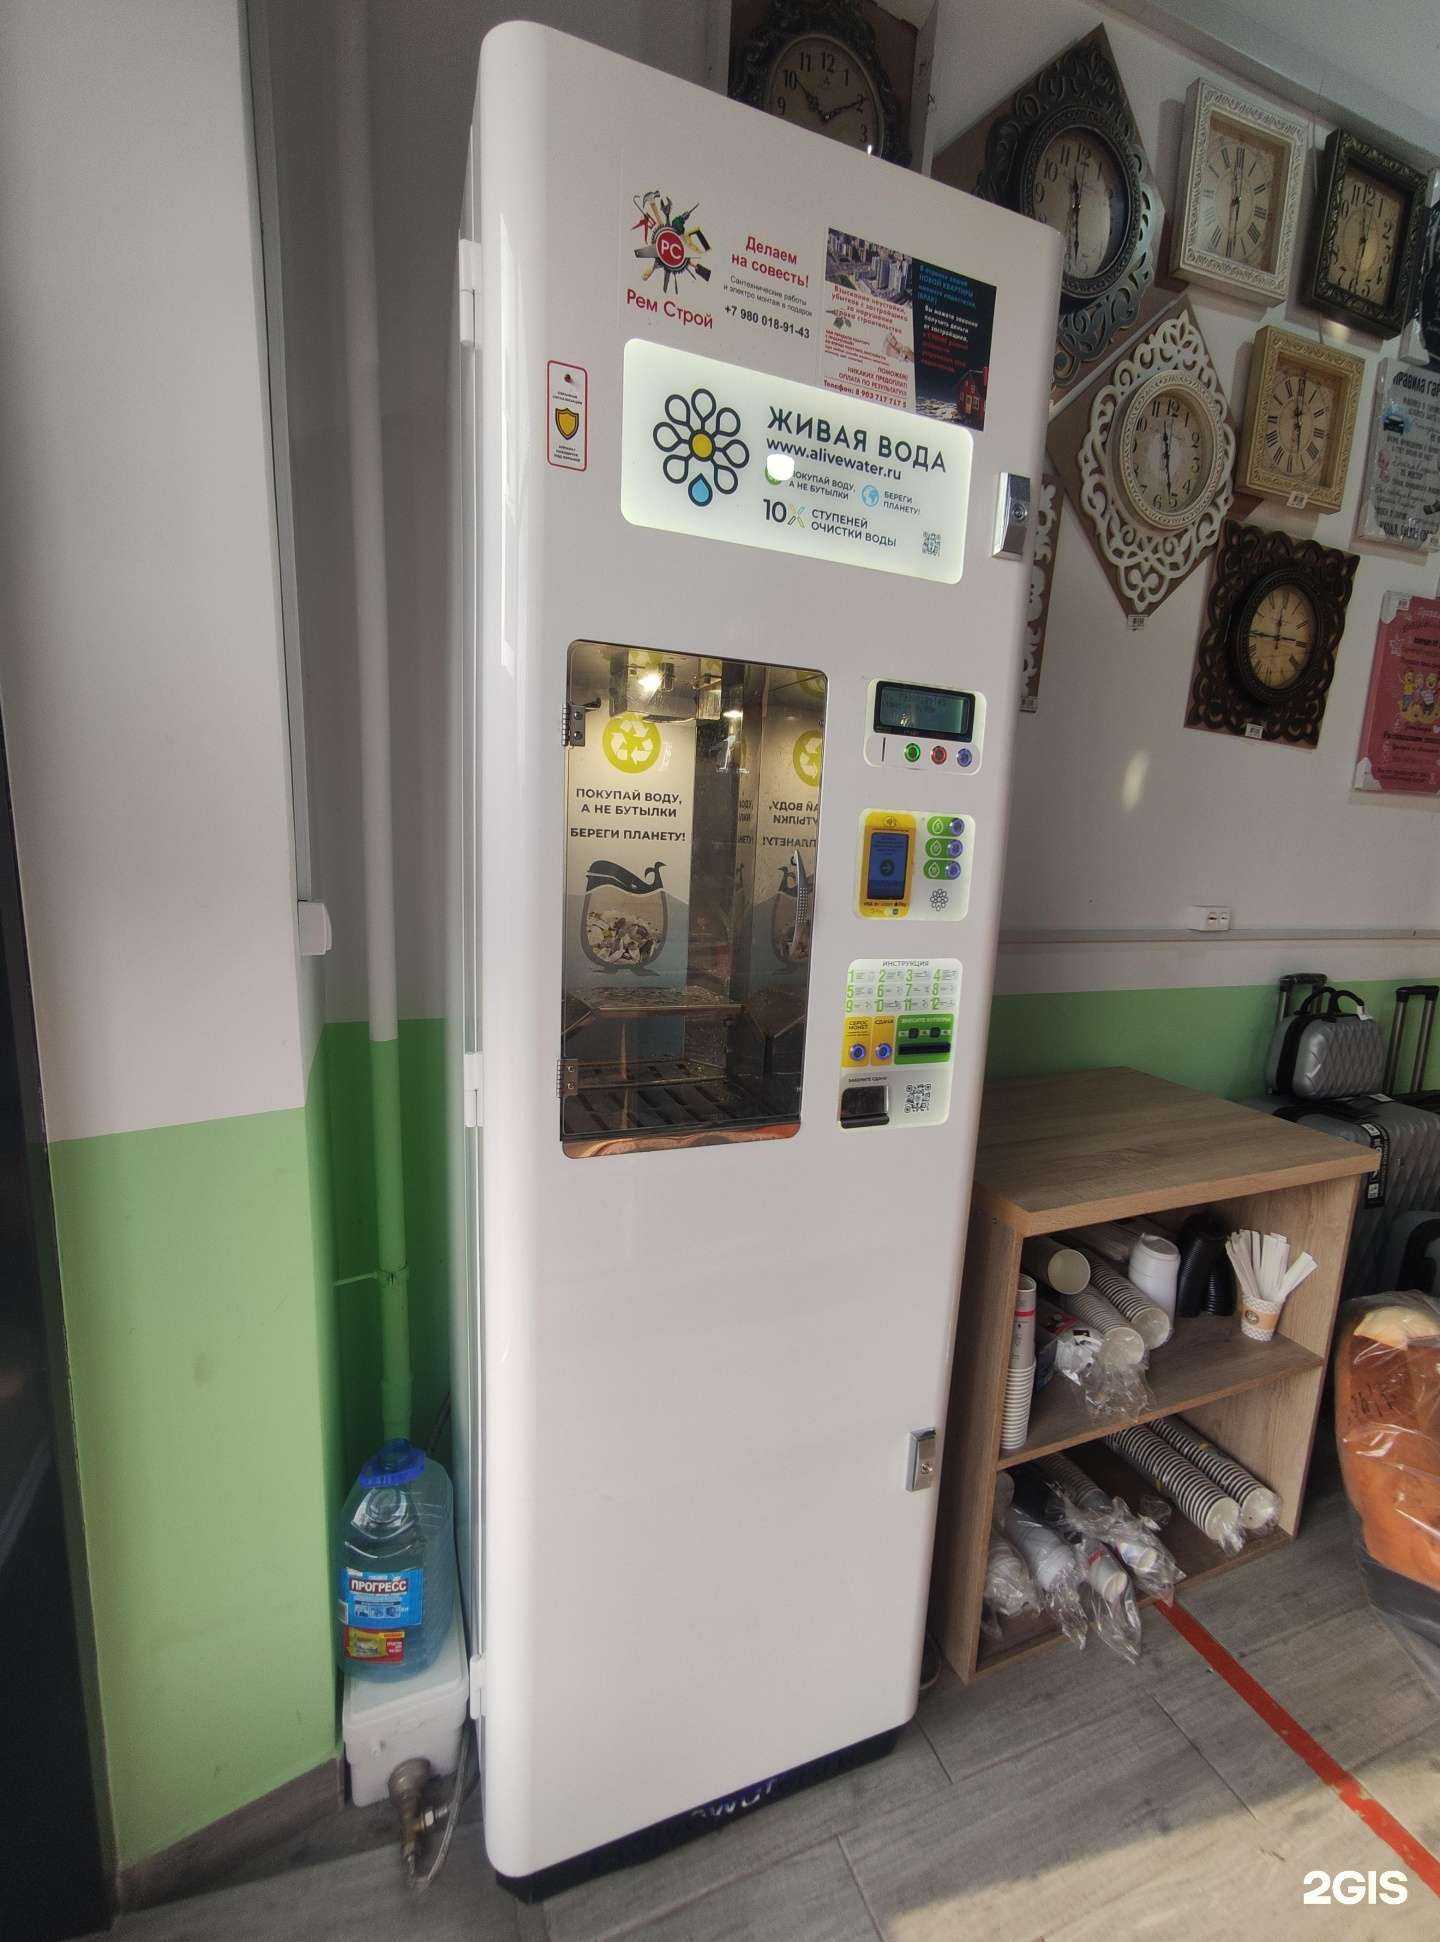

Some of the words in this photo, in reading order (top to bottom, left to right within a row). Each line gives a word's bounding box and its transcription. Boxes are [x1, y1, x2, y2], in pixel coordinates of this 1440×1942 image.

[800, 51, 811, 72] 11
[822, 51, 834, 73] 12
[661, 240, 681, 260] РС
[745, 235, 797, 265] Делаем
[731, 253, 748, 268] на
[751, 260, 809, 288] совесть!
[626, 288, 658, 313] Рем
[663, 300, 713, 329] Строй
[784, 293, 807, 306] работы
[724, 305, 737, 316] +7
[740, 308, 759, 323] 980
[761, 315, 810, 339] 018-91-43
[767, 405, 868, 453] ЖИВАЯ
[879, 434, 946, 473] ВОДА
[766, 437, 902, 480] www.alivewater.ru
[798, 482, 809, 491] НЕ
[810, 484, 849, 500] БУТЫЛКИ
[831, 479, 856, 493] ВОДУ,
[811, 508, 868, 529] СТУПЕНЕЙ
[811, 521, 862, 540] ОЧИСТКИ
[865, 533, 897, 547] ВОДЫ
[576, 788, 641, 801] ПОКУПАЙ
[644, 792, 682, 805] ВОДУ,
[580, 803, 591, 813] А
[594, 804, 612, 814] НЕ
[615, 805, 677, 818] БУТЫЛКИ
[570, 827, 620, 839] БЕРЕГИ
[623, 829, 686, 842] ПЛАНЕТУ!
[351, 1579, 407, 1592] ПРОГРЕСС
